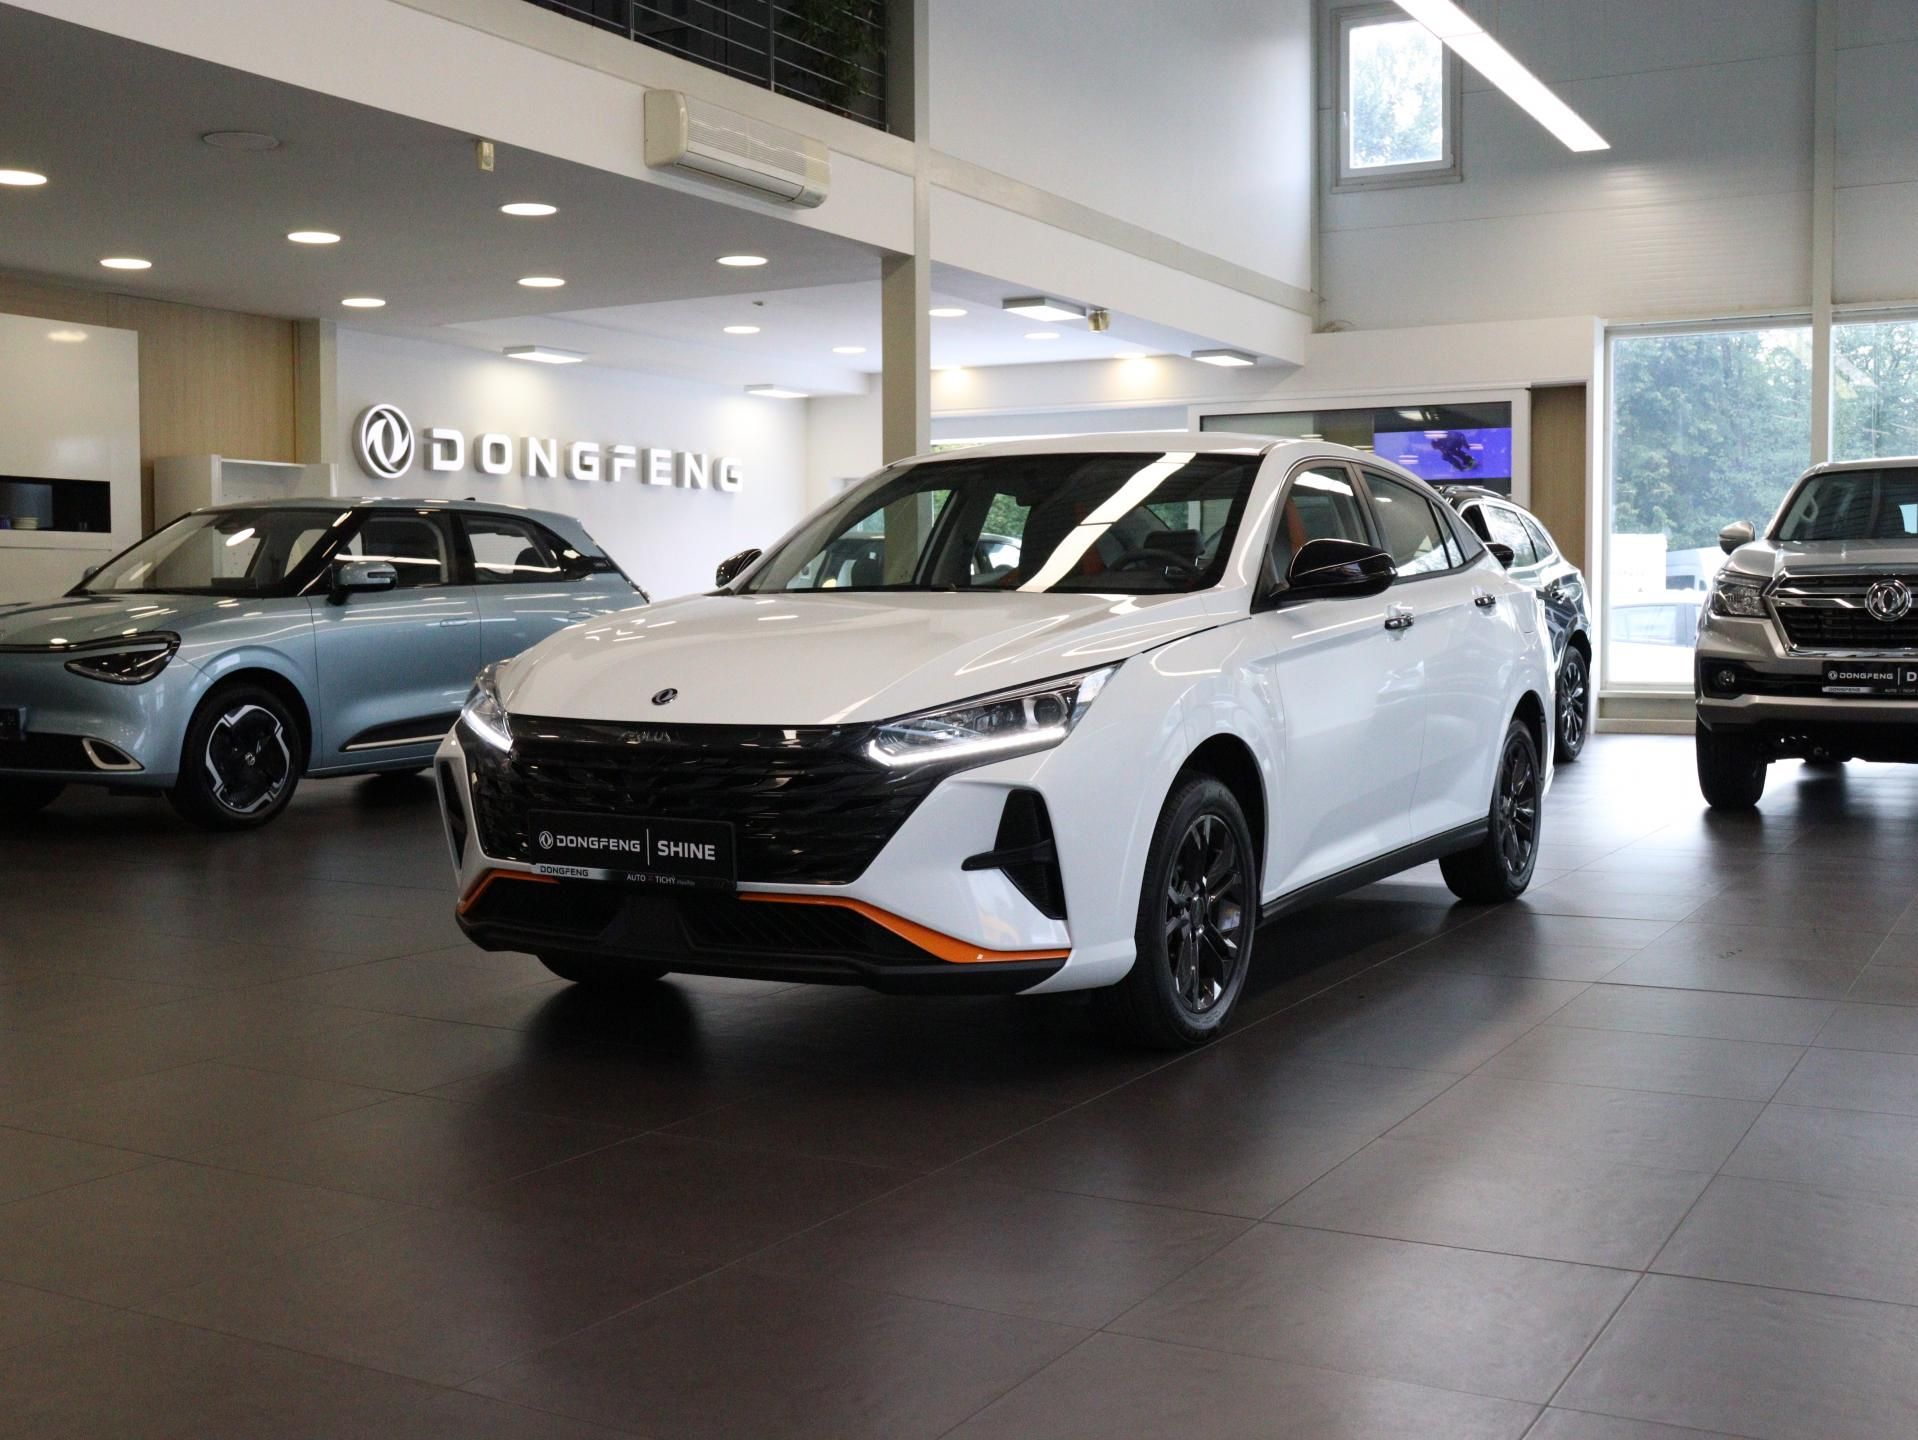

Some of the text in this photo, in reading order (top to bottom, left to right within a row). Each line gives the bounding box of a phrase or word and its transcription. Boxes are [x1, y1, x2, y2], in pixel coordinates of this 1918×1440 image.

[424, 417, 744, 493] DONGFENG
[1839, 672, 1894, 680] DONGFENG
[556, 835, 716, 861] DONGFENG SHINE
[540, 865, 589, 877] DONGFENG
[626, 873, 646, 882] AUTO
